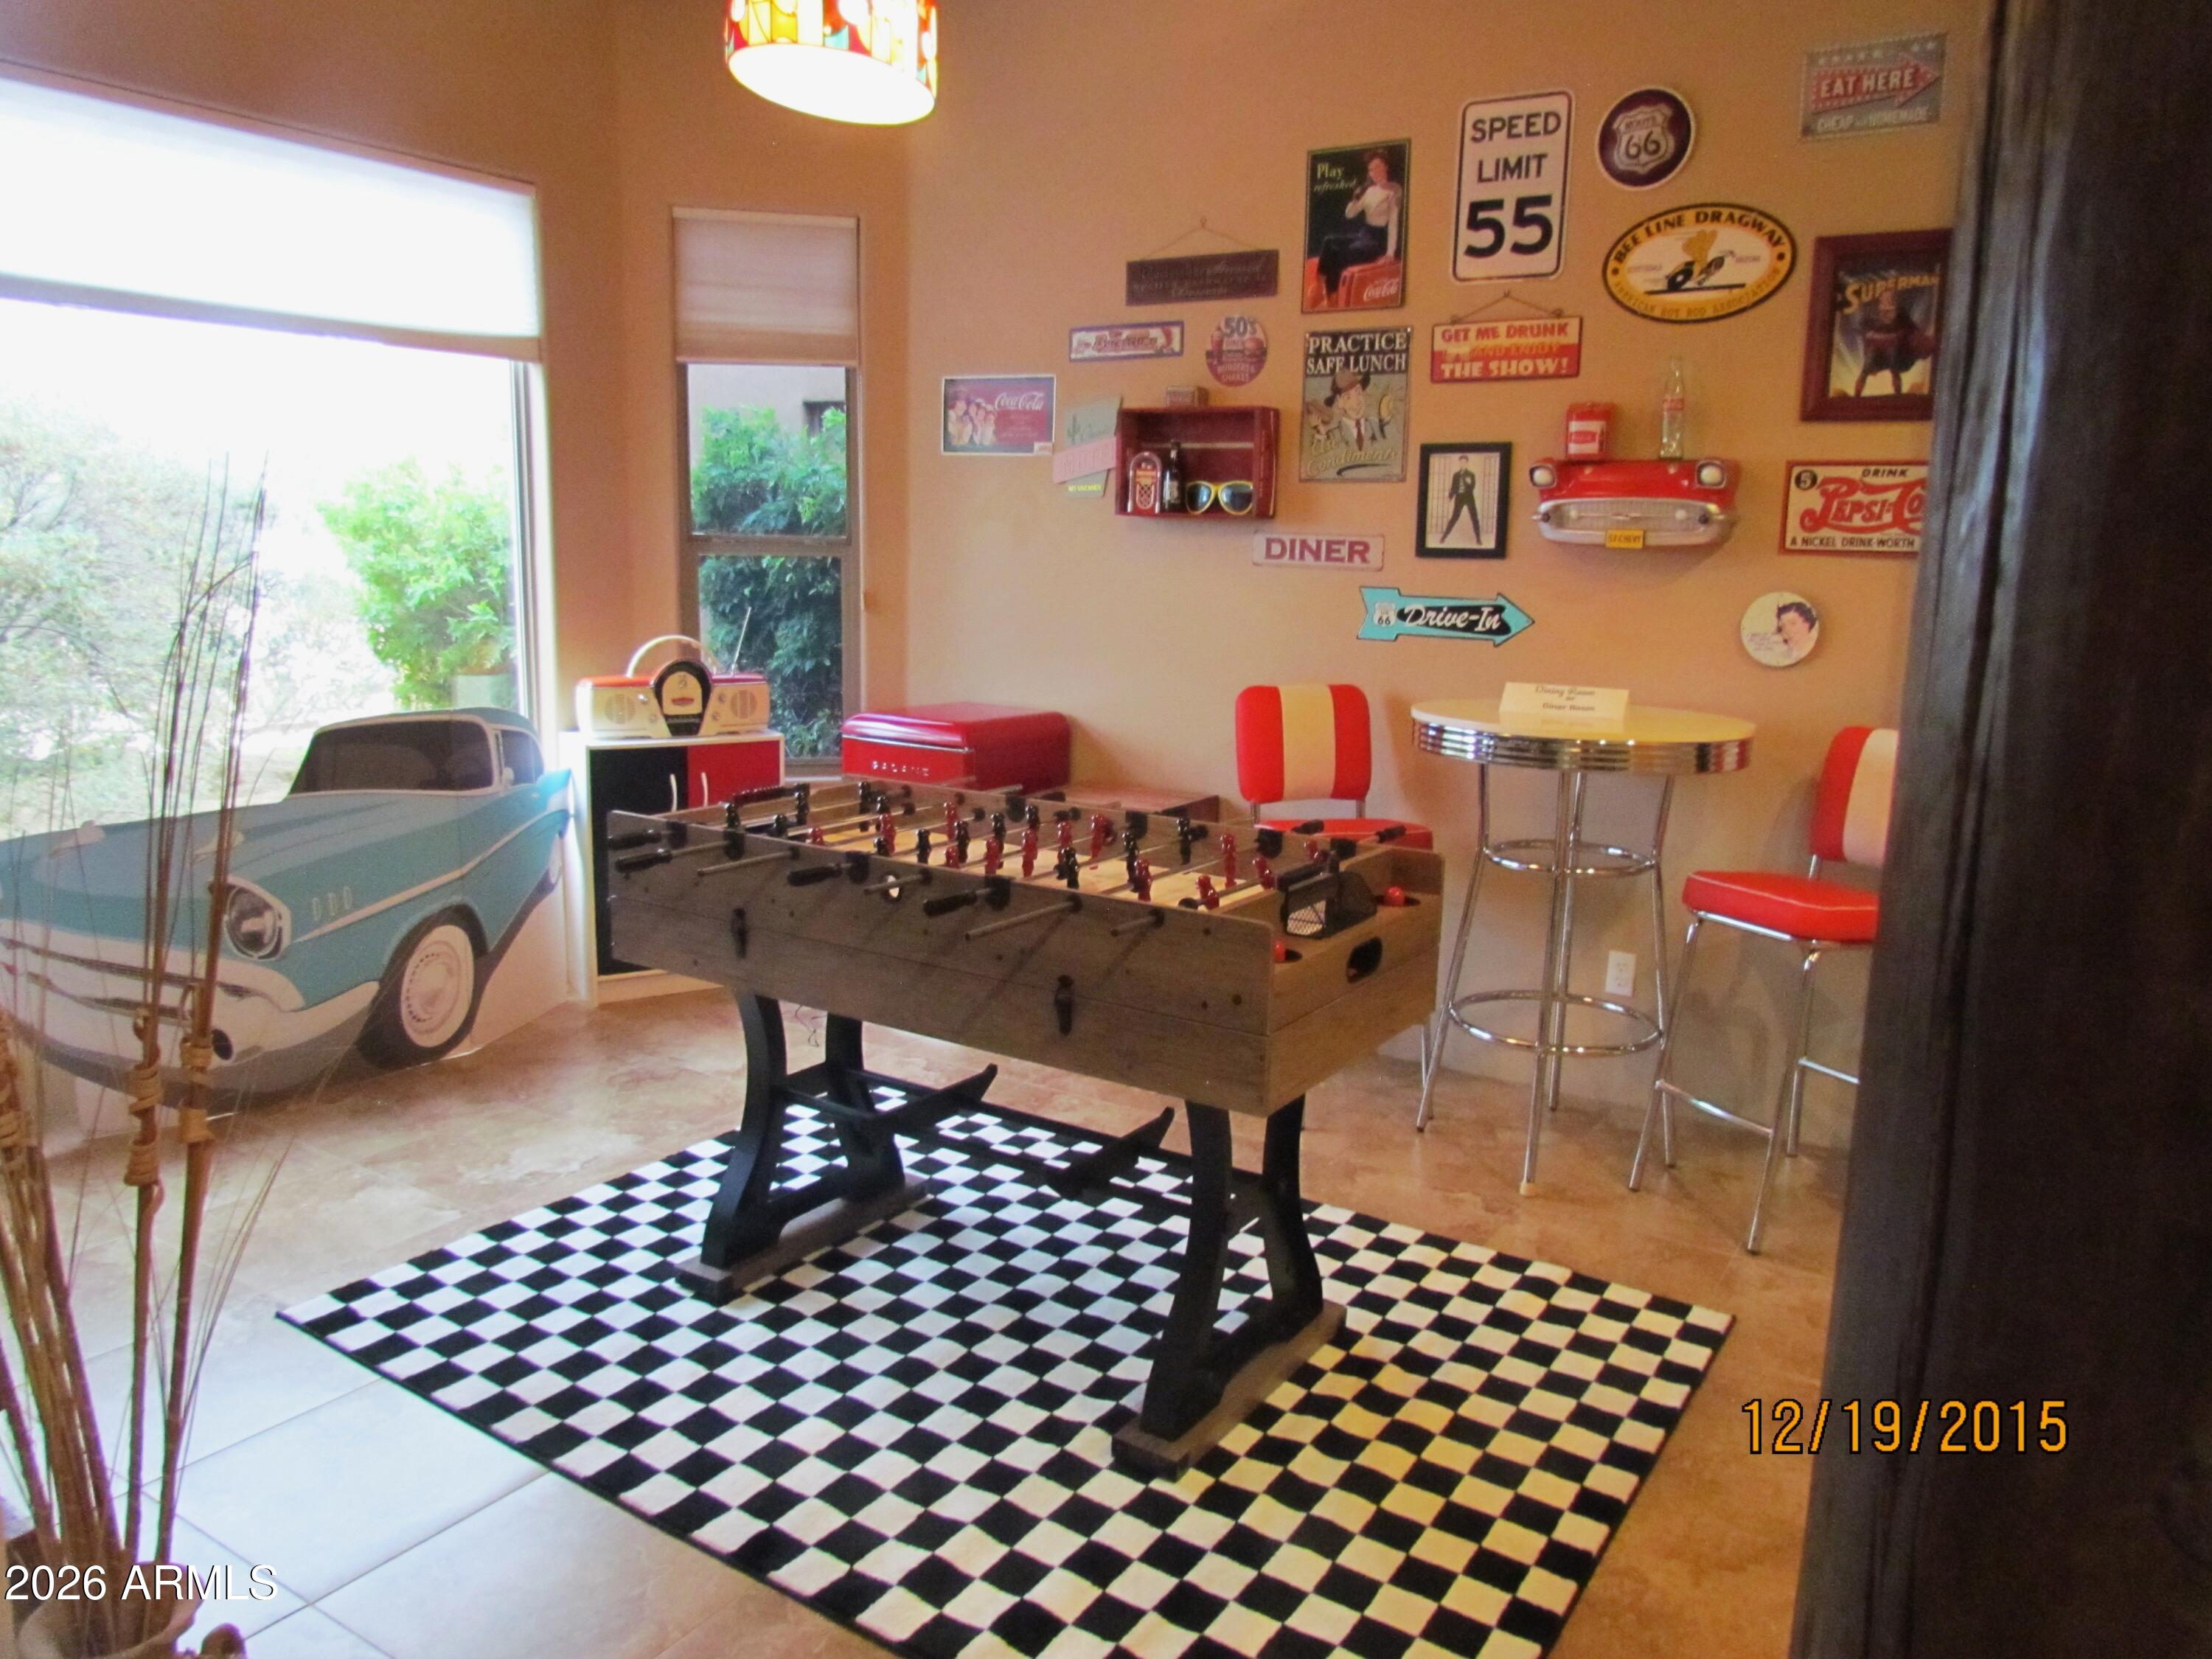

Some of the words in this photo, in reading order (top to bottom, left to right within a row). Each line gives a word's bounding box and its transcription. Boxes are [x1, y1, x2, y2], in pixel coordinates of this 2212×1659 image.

[1820, 75, 1857, 97] EAT
[1862, 68, 1914, 93] HERE
[1470, 111, 1561, 142] SPEED
[1625, 130, 1660, 159] 66
[1317, 162, 1344, 179] Play
[1477, 153, 1548, 183] LIMIT
[1464, 194, 1553, 258] 55
[1613, 233, 1642, 263] BEE
[1645, 215, 1686, 237] LINE
[1695, 210, 1785, 248] DRAGWAY
[1842, 275, 1940, 315] SUPERMAN
[1308, 333, 1408, 355] PRACTICE
[1441, 328, 1471, 343] GET
[1475, 326, 1500, 341] ME
[1506, 322, 1569, 339] DRUNK
[1349, 352, 1407, 373] LUNCH
[1441, 361, 1484, 379] THE
[1488, 357, 1570, 377] SHOW!
[1306, 448, 1397, 476] Condiments
[1860, 467, 1909, 478] DRINK
[1264, 537, 1371, 564] DINER
[1790, 536, 1797, 546] A
[1801, 536, 1837, 547] NICKEL
[1841, 537, 1874, 548] DRINK
[1876, 538, 1915, 549] WORTH
[1377, 615, 1391, 625] 66
[1404, 604, 1501, 631] Drive-In
